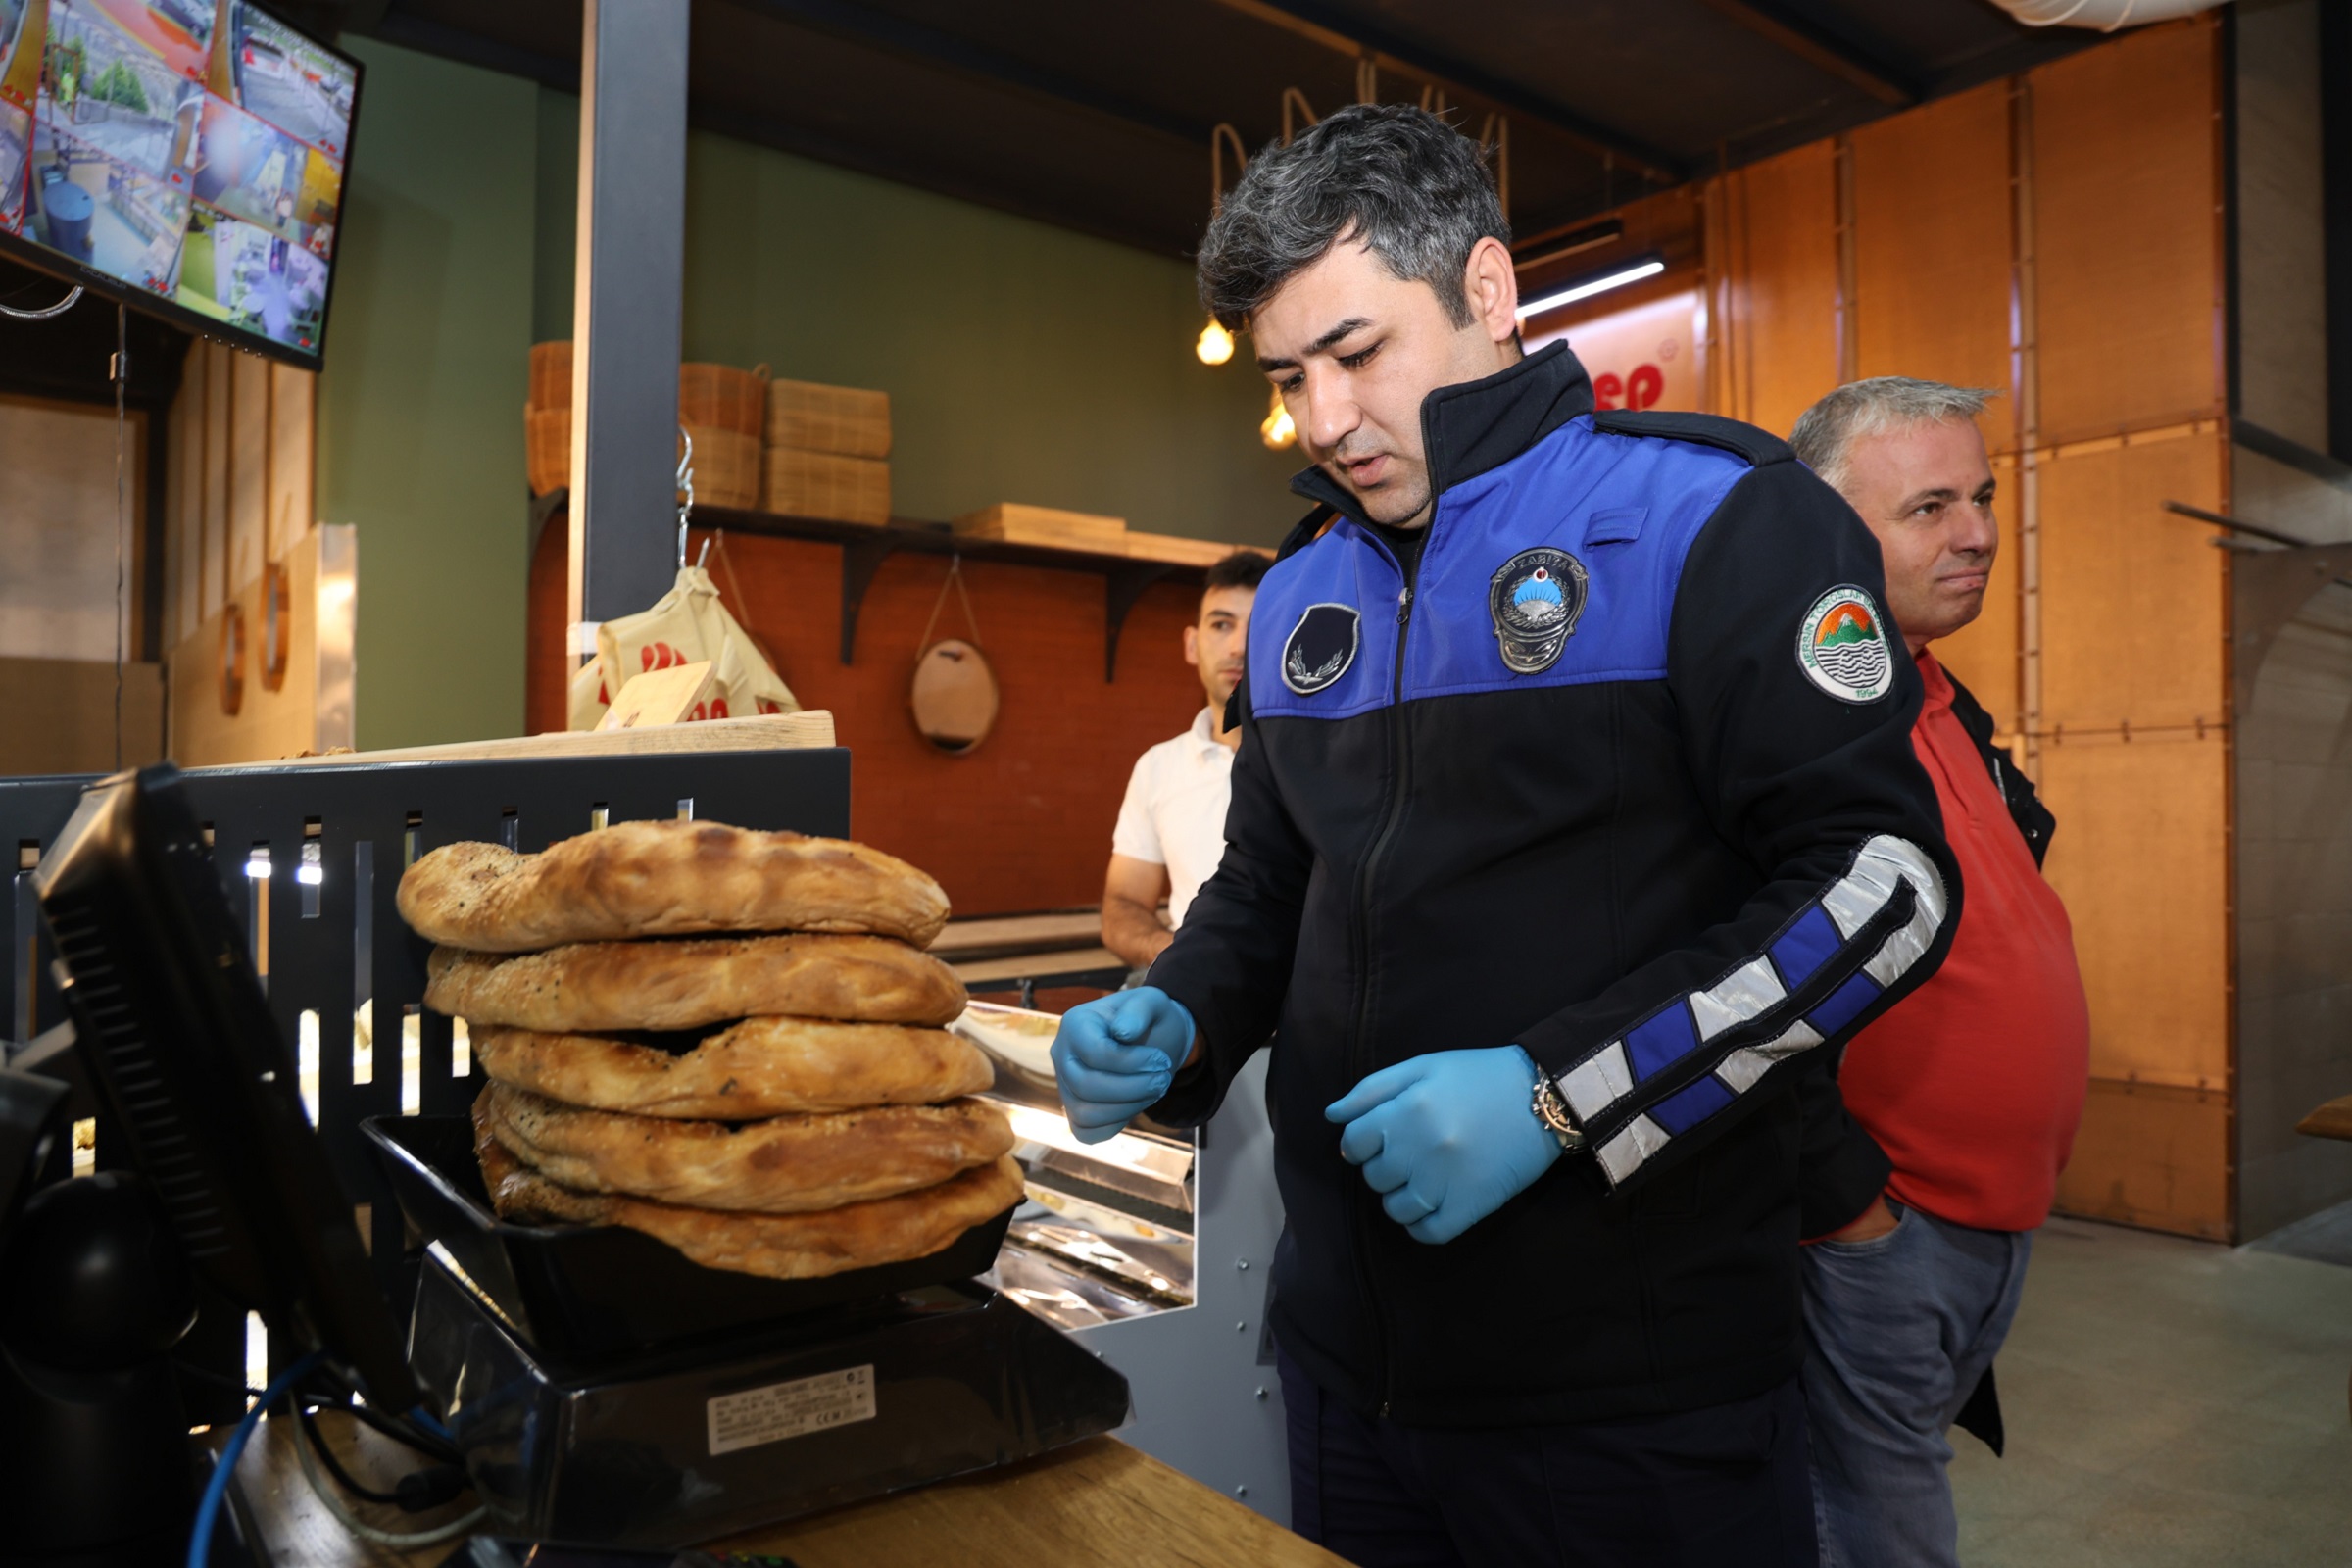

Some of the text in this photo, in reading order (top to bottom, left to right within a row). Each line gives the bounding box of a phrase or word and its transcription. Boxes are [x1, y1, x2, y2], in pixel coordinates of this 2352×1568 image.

[1594, 364, 1664, 411] ep
[1810, 589, 1862, 619] TOROSLAR
[1856, 686, 1879, 698] 1994
